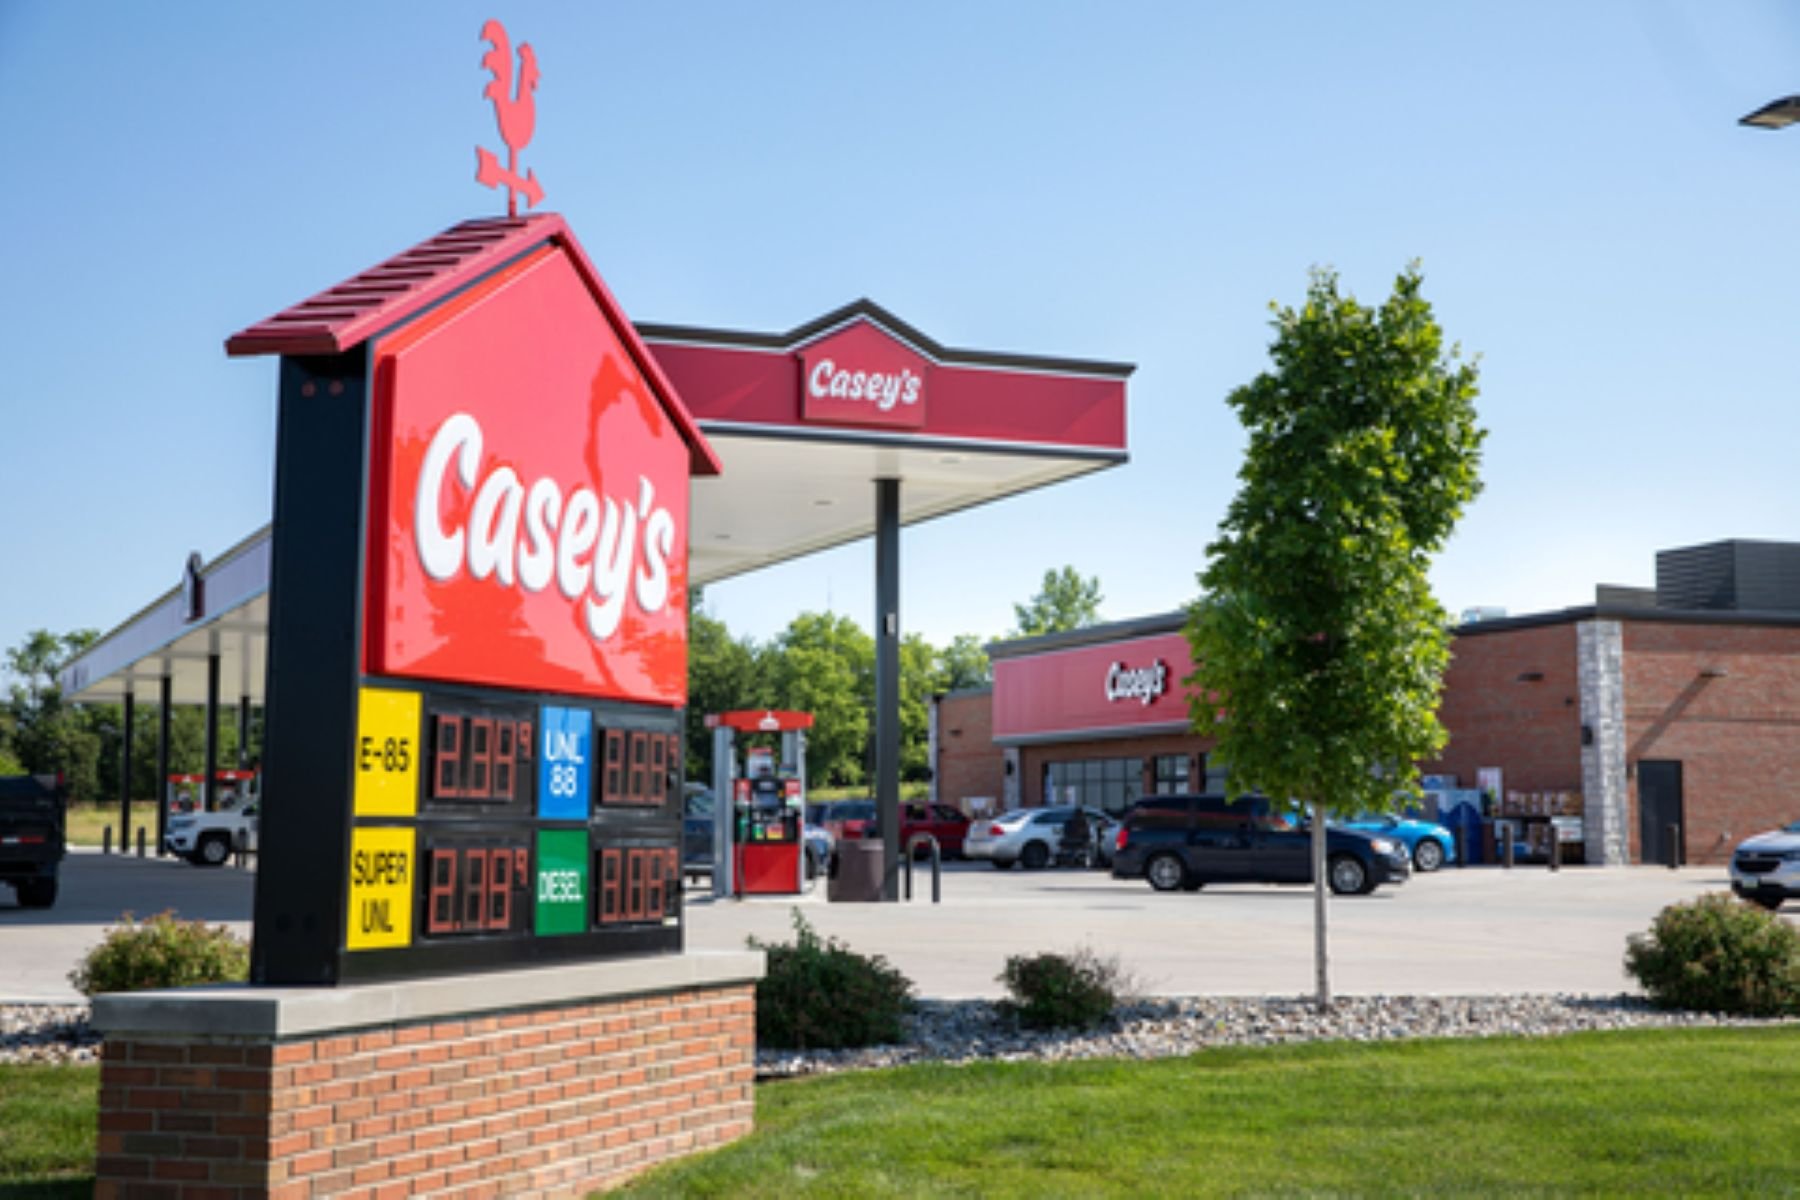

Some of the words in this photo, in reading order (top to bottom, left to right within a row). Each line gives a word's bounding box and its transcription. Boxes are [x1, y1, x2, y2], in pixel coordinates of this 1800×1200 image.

[809, 359, 921, 411] Casey's
[415, 412, 675, 640] Casey's
[361, 737, 409, 771] E-85
[545, 729, 584, 764] UNL
[550, 764, 577, 798] 88
[352, 850, 408, 886] SUPER
[538, 871, 584, 903] DIESEL
[361, 899, 394, 933] UNL
